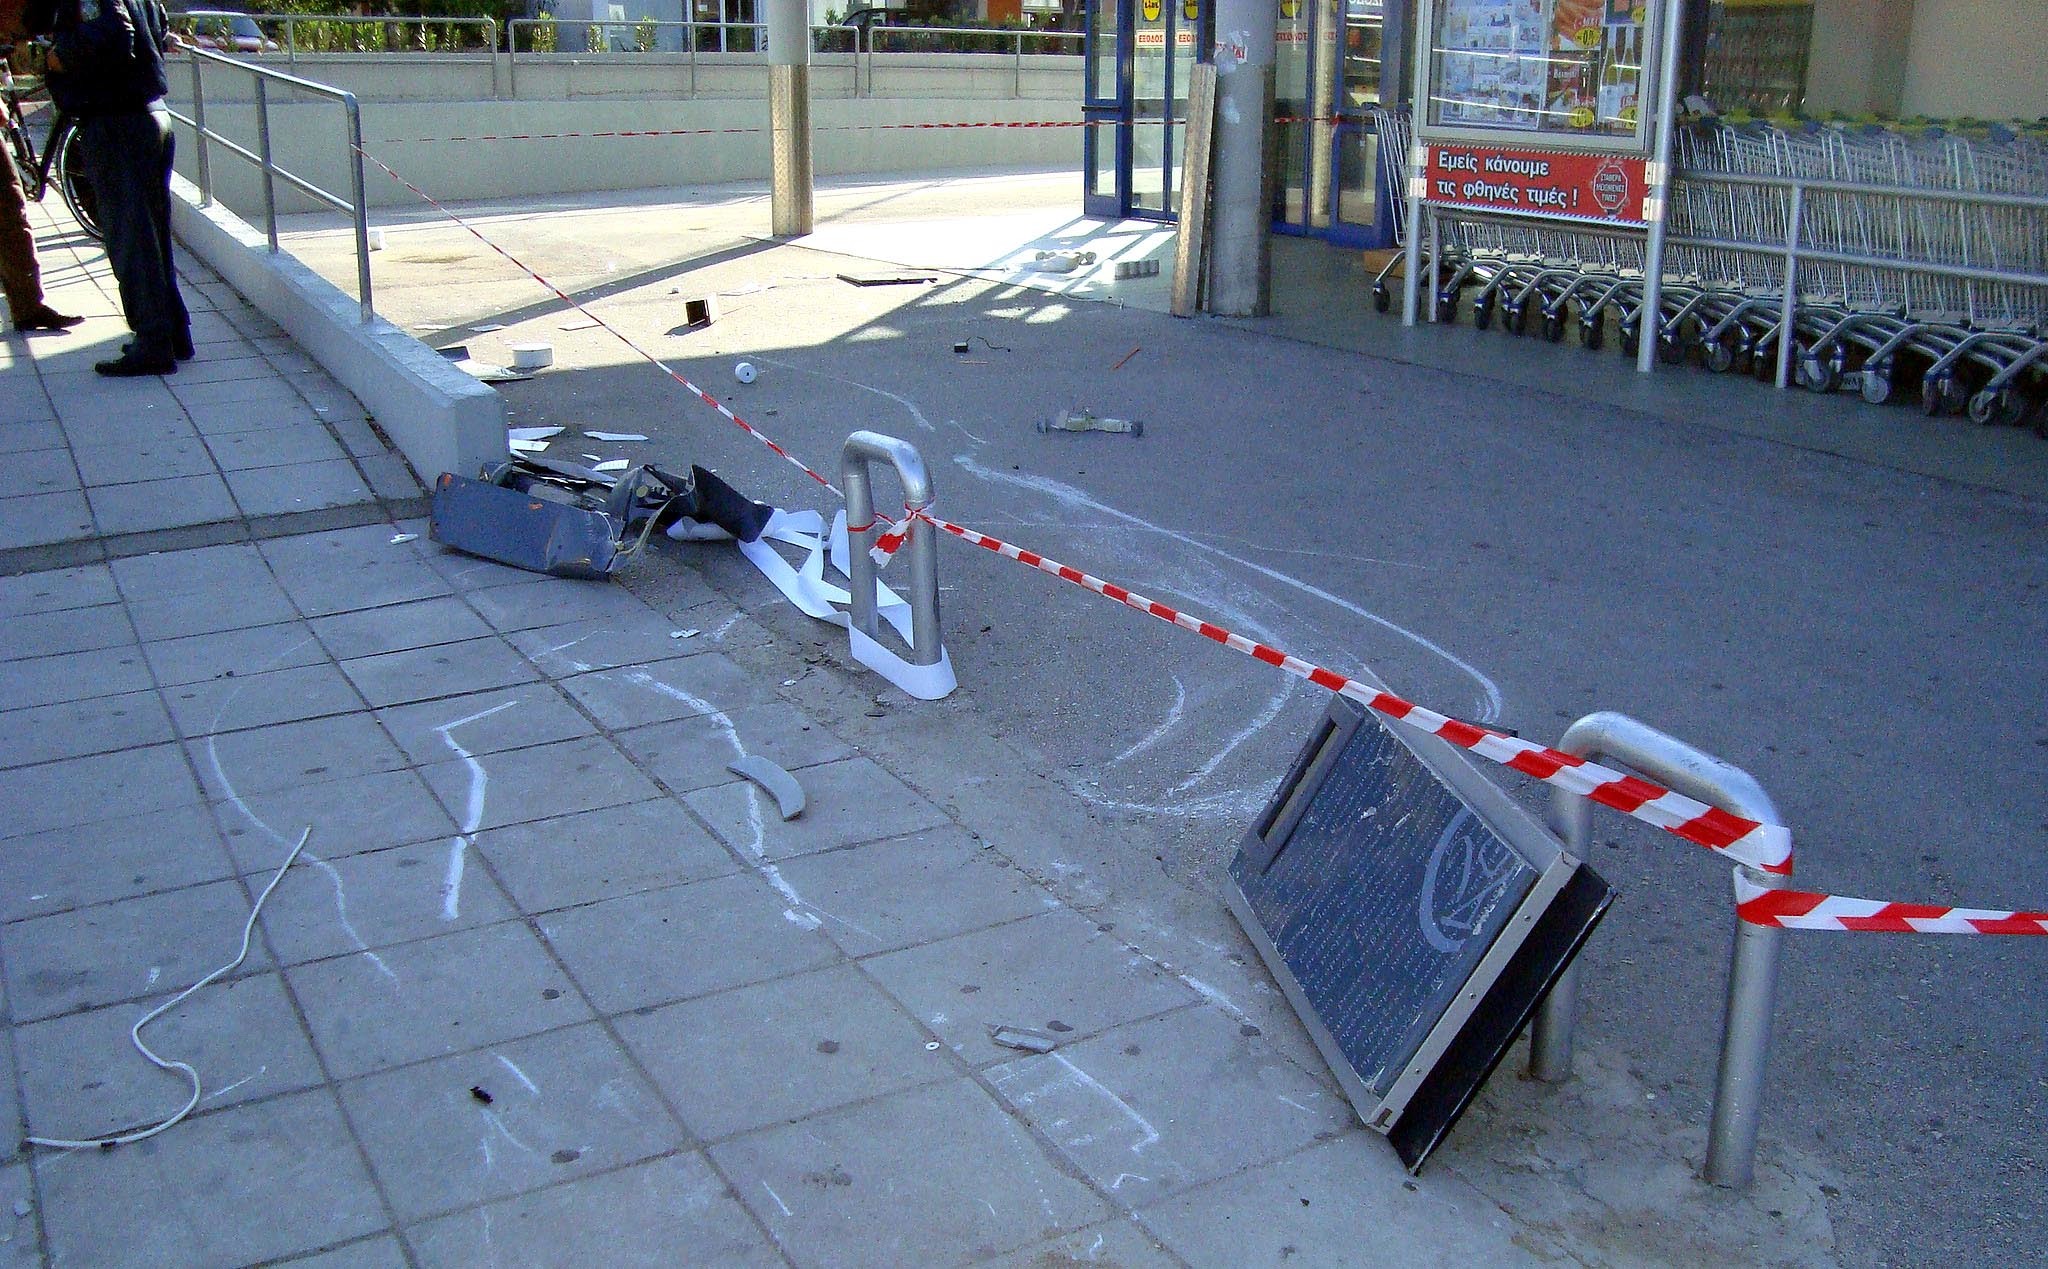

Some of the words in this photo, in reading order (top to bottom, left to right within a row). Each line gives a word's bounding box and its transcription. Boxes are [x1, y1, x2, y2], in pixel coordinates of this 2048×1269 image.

[1438, 150, 1479, 173] Εμείς
[1485, 154, 1549, 178] κάνουμε
[1436, 180, 1457, 198] τις
[1462, 180, 1519, 204] φθηνές
[1526, 186, 1567, 209] τιμές
[1572, 187, 1578, 207] !
